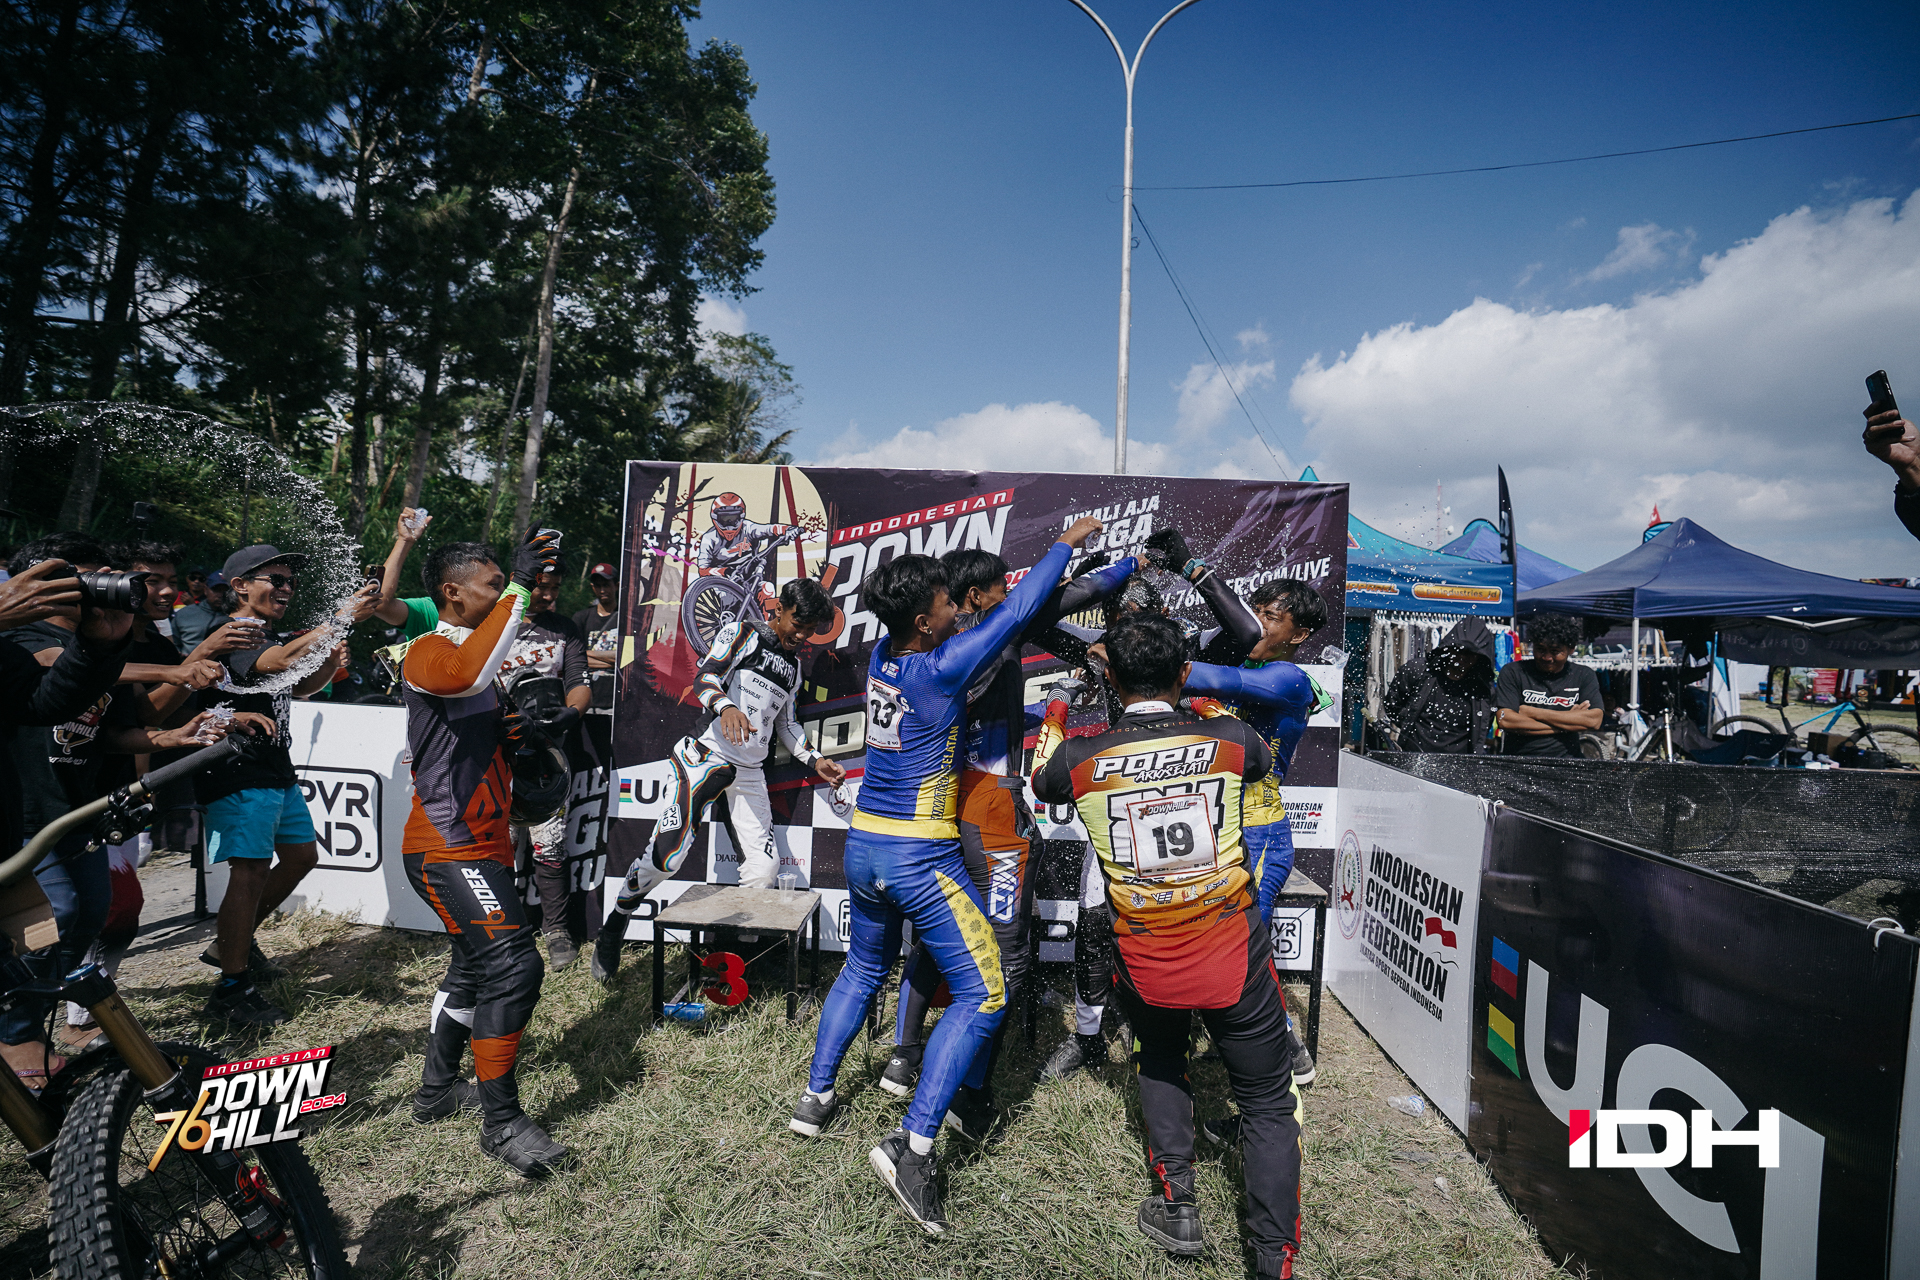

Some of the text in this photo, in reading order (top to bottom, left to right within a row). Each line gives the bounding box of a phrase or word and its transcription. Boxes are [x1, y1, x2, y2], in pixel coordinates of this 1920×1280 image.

[838, 491, 1007, 541] INDONESIAN
[1122, 495, 1160, 517] AJA
[1345, 582, 1398, 595] PPAREL
[752, 677, 786, 700] POLYGON
[1092, 740, 1220, 782] POPO
[297, 779, 371, 818] PVR
[315, 821, 371, 858] ND.
[1152, 822, 1195, 859] 19
[1290, 821, 1319, 830] RATION
[460, 867, 502, 915] RIDER
[1369, 844, 1464, 925] INDONESIAN
[1272, 922, 1296, 937] VR
[1365, 877, 1424, 944] CYCLING
[1273, 939, 1296, 954] ND.
[1361, 909, 1448, 1003] FEDERATION
[702, 951, 749, 1007] 3
[1390, 969, 1410, 995] SEPEDA
[1409, 985, 1443, 1022] INDONESIA
